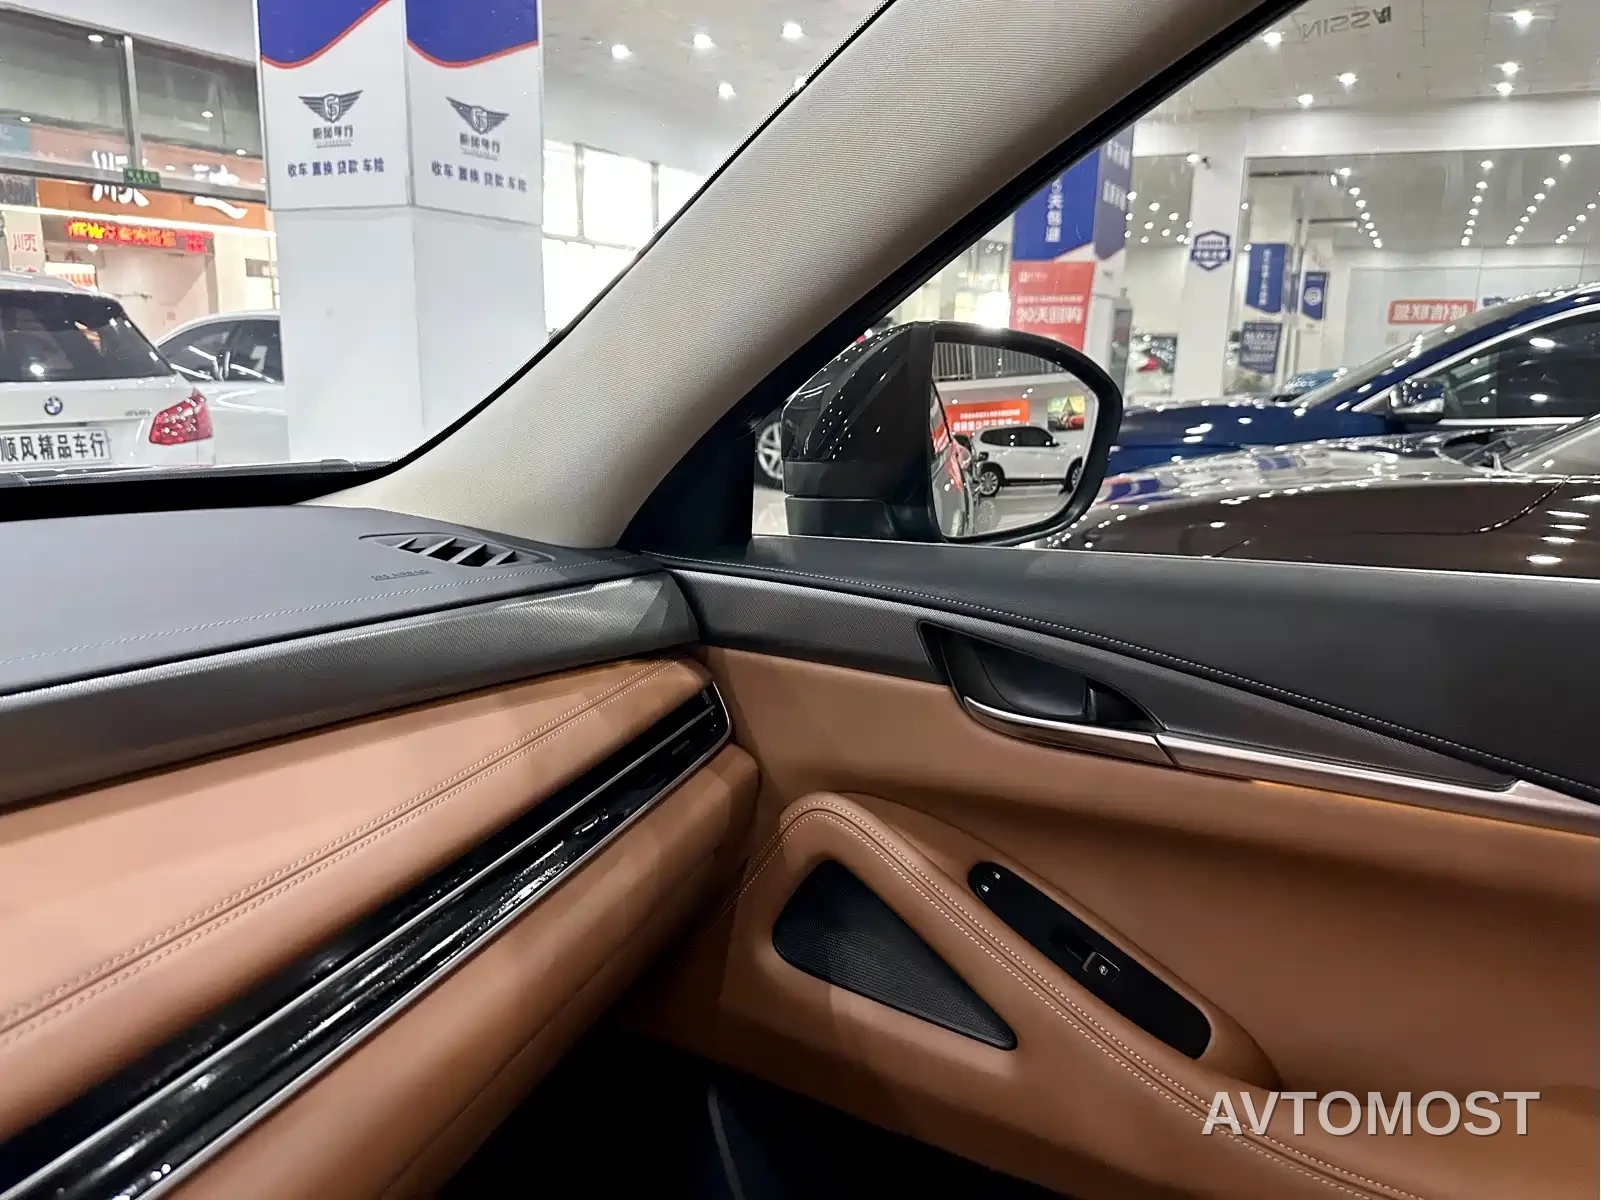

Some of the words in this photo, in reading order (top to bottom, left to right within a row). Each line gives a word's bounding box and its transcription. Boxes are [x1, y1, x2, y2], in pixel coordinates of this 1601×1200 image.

[288, 162, 308, 178] 收车
[312, 161, 333, 176] 置换
[337, 159, 359, 175] 贷款
[363, 157, 384, 173] 车险
[432, 160, 453, 179] 收车
[0, 431, 105, 462] 顺风精品车行
